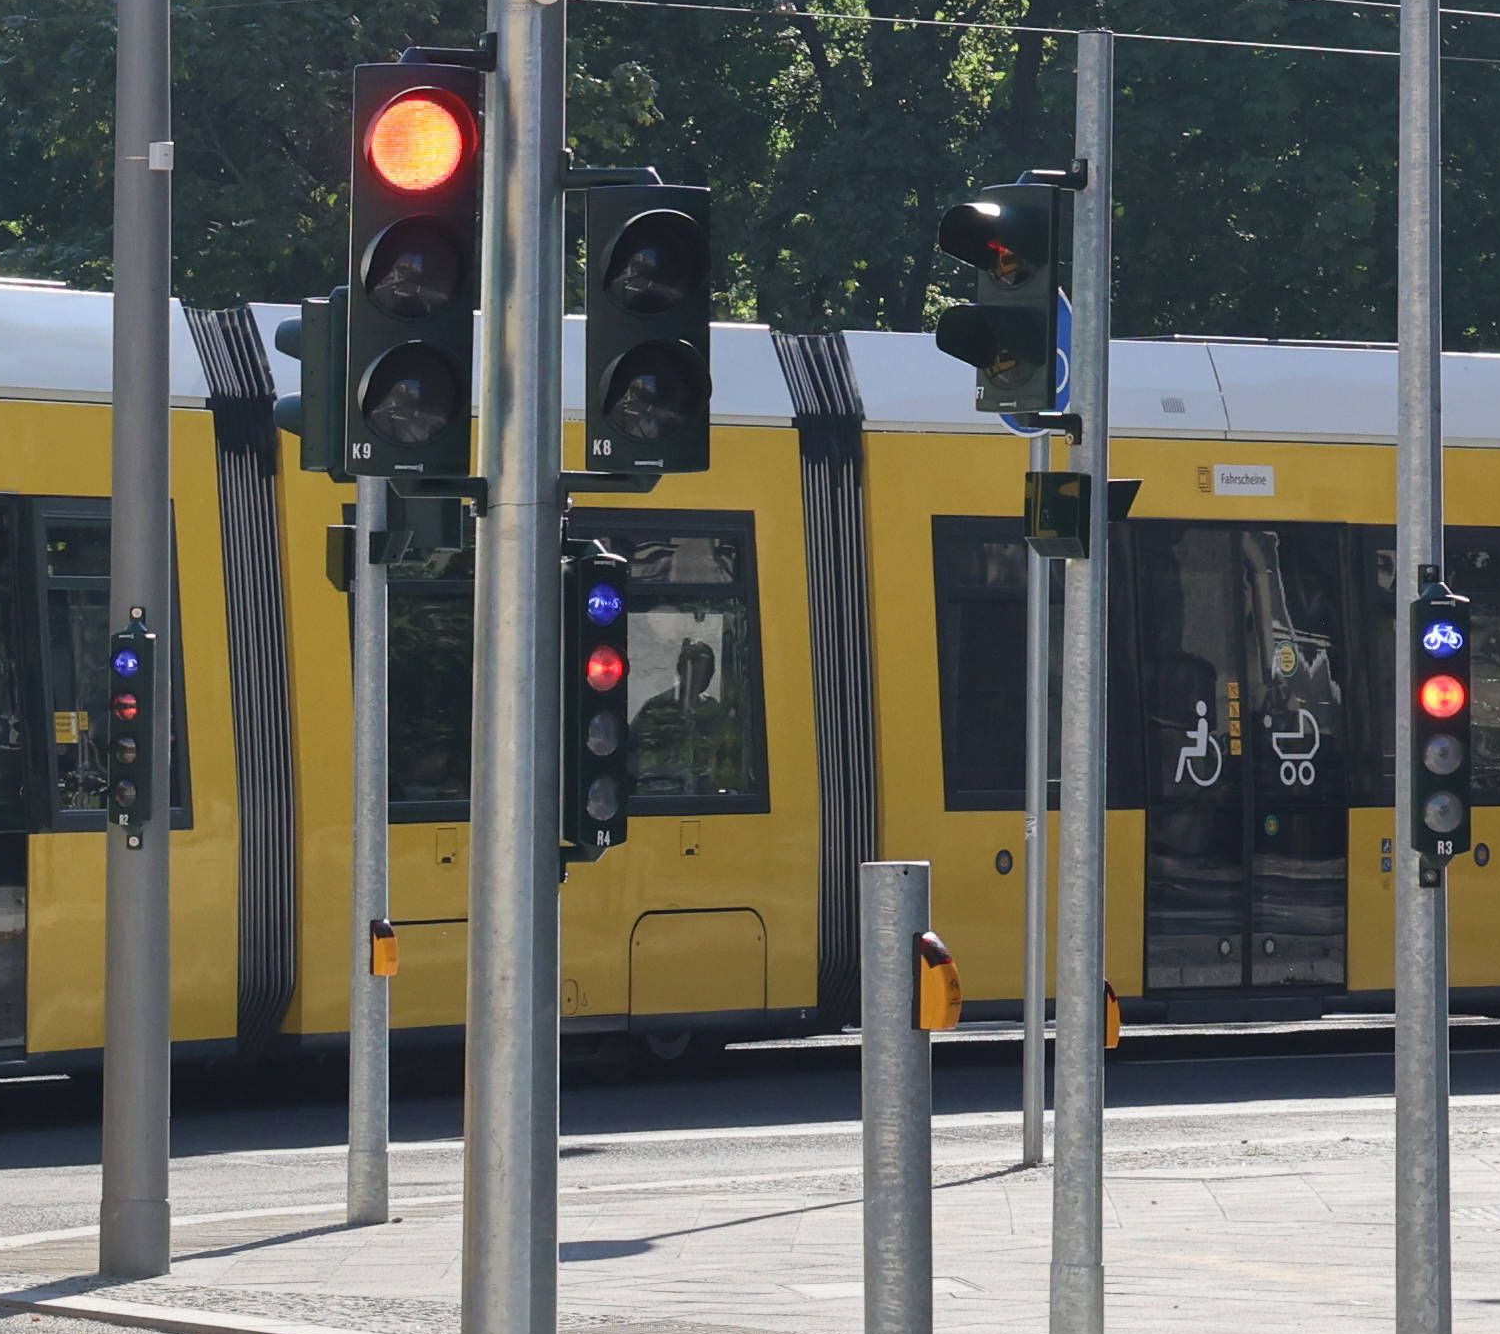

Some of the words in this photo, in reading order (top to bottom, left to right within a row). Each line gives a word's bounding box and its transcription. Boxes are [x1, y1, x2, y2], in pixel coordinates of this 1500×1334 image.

[351, 442, 372, 460] K9
[592, 438, 613, 456] K8
[1220, 471, 1268, 486] Fahrscheine
[596, 829, 612, 847] R4
[1436, 839, 1454, 856] R3
